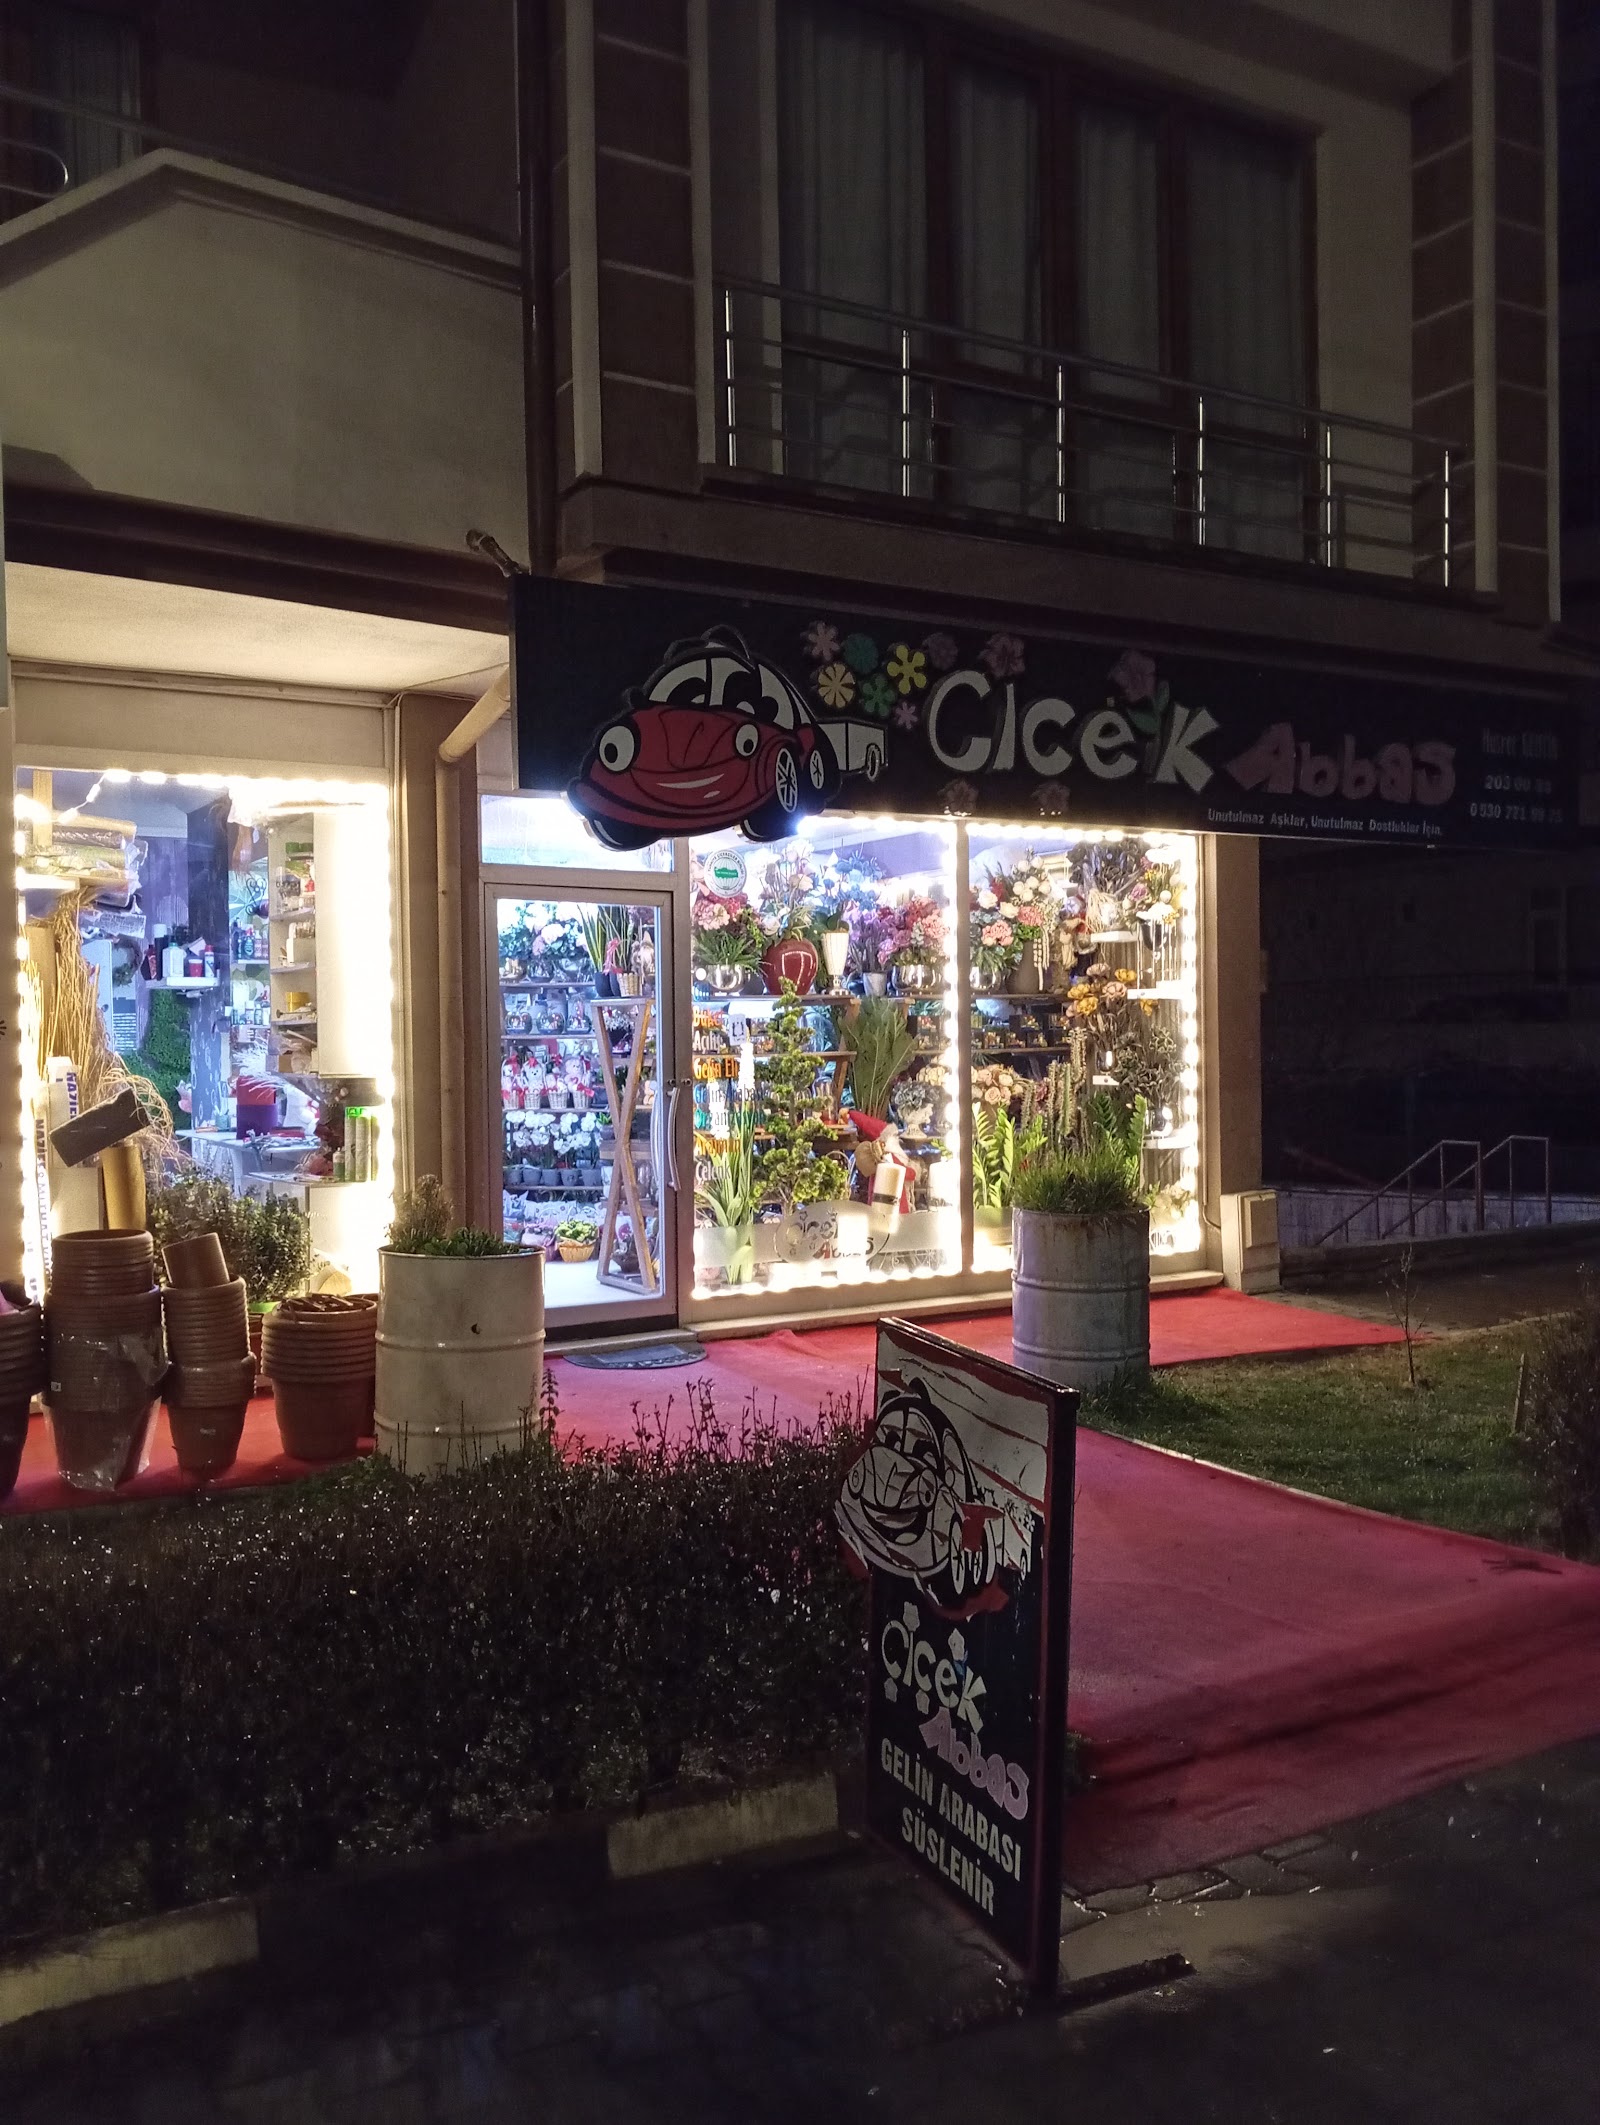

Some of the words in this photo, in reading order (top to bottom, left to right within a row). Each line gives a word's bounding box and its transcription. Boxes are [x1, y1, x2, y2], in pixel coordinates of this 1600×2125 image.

[1225, 720, 1456, 806] Abbas
[1207, 807, 1264, 825] Unutulmaz
[1311, 815, 1364, 831] Unutulmaz
[1369, 819, 1420, 835] Dostluklar
[881, 1737, 934, 1806] GELİN
[939, 1782, 1022, 1882] ARABASI
[919, 1706, 1030, 1820] Abbas
[902, 1807, 995, 1917] SÜSLENİR
